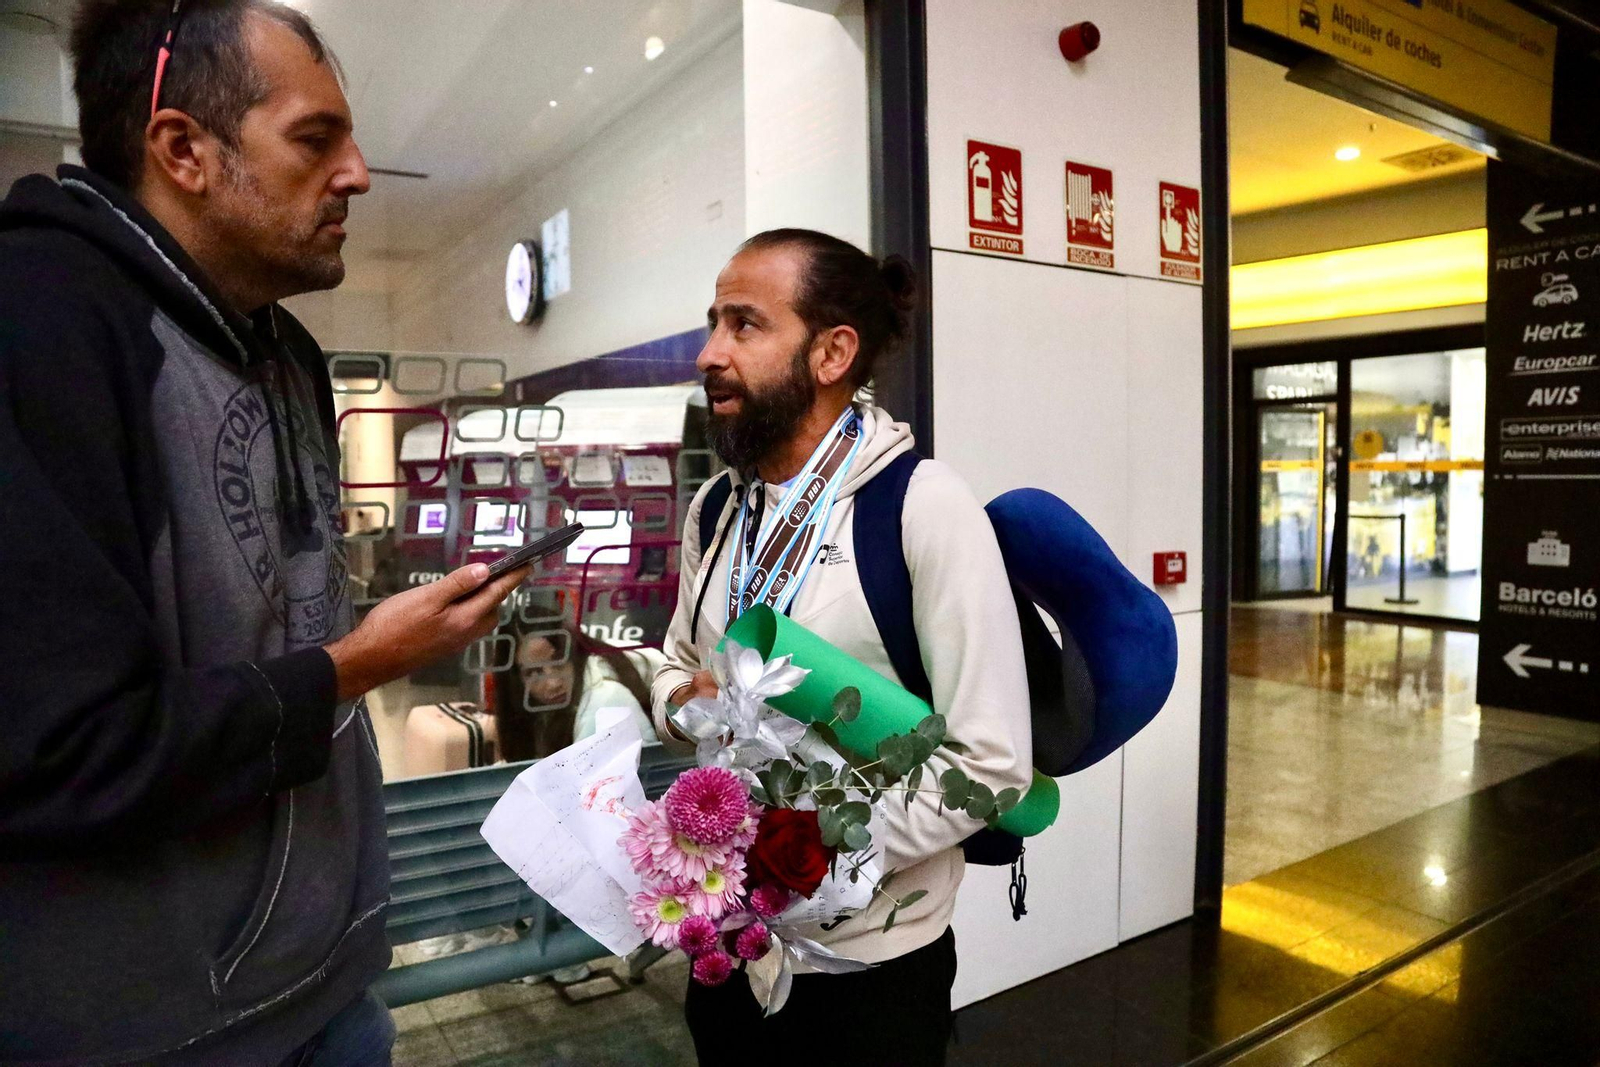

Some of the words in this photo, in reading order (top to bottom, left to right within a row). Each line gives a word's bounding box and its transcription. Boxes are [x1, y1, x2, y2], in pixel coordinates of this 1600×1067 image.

[1332, 3, 1382, 42] Alquiler
[1386, 28, 1401, 51] de
[1404, 38, 1442, 69] coches
[972, 234, 1020, 252] EXTINTOR
[1070, 248, 1096, 259] BOCA
[1099, 251, 1111, 260] DE
[1070, 254, 1112, 267] INCENDIO
[1495, 251, 1552, 271] RENT
[1554, 249, 1570, 263] A
[1574, 243, 1600, 260] CA
[1522, 320, 1586, 343] Hertz
[1513, 353, 1597, 371] Europcar
[1527, 385, 1581, 406] AVIS
[1507, 419, 1600, 436] enterprise
[408, 571, 445, 585] ren
[1499, 581, 1598, 609] Barceló
[1498, 603, 1537, 616] HOTELS
[1538, 606, 1546, 617] &
[1548, 607, 1598, 621] RESORTS
[580, 614, 645, 642] nfe
